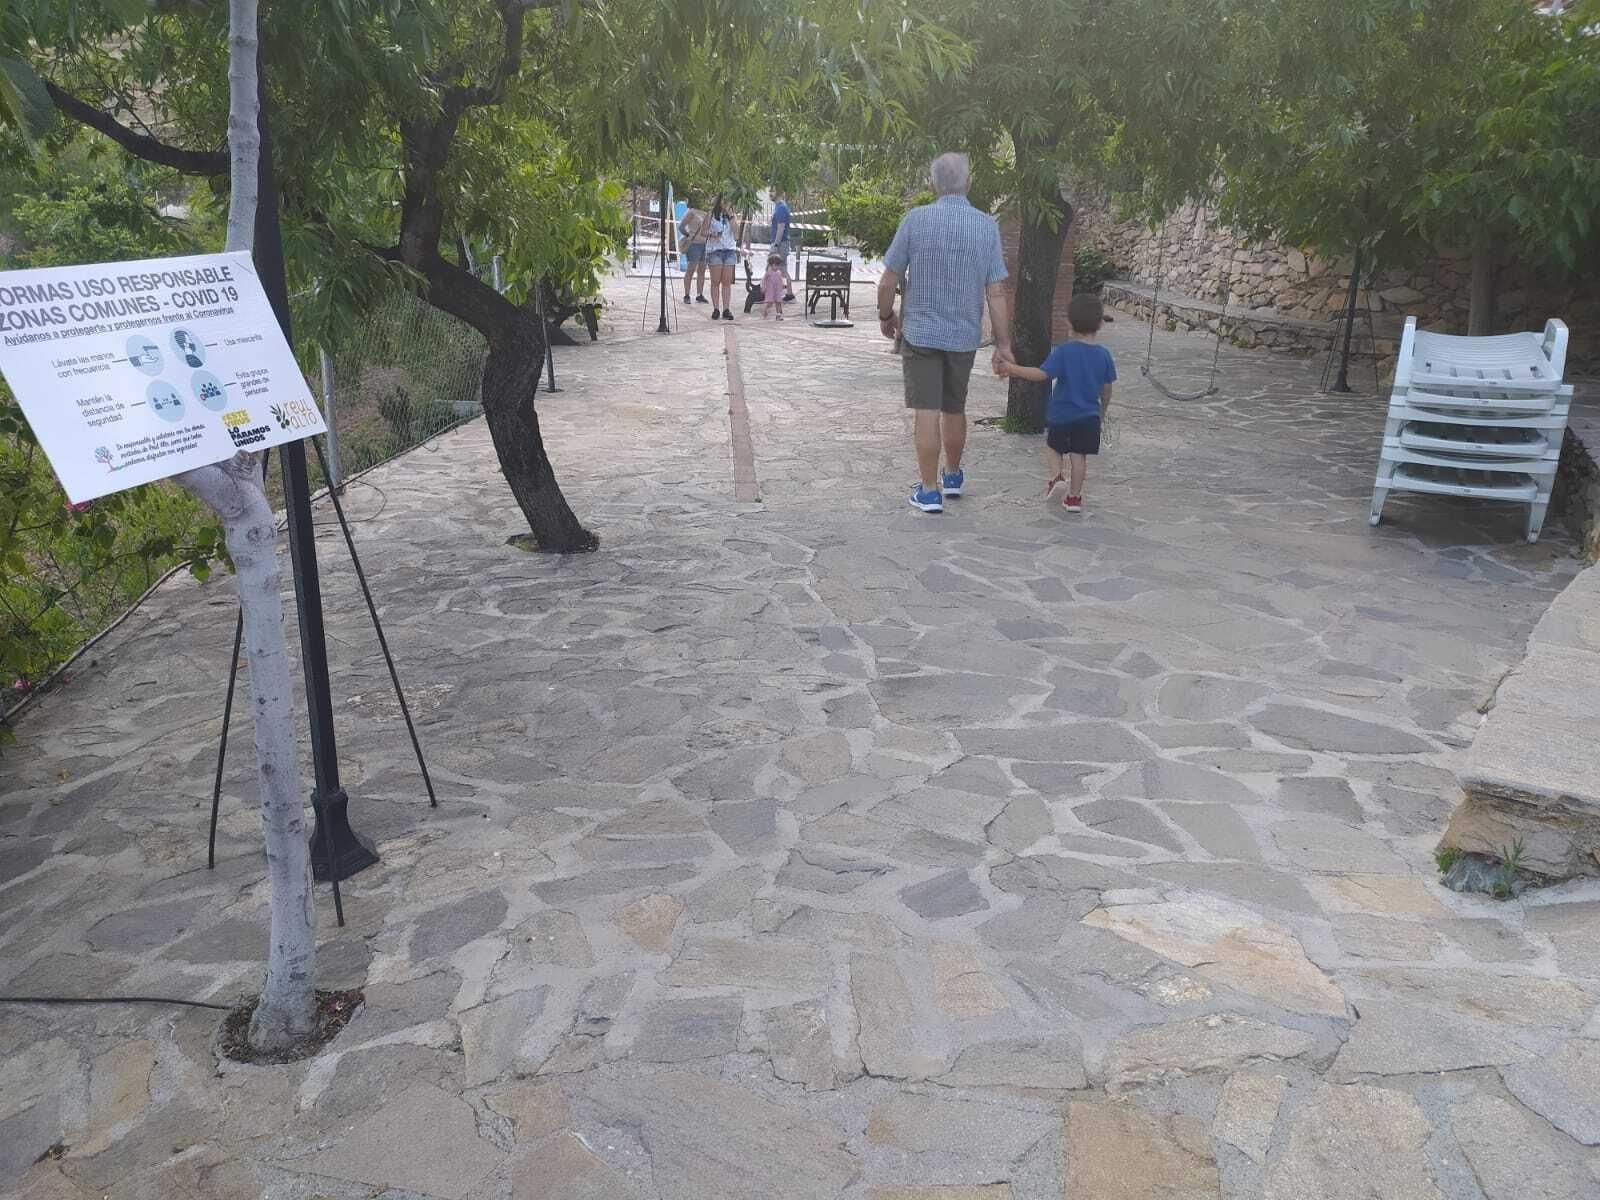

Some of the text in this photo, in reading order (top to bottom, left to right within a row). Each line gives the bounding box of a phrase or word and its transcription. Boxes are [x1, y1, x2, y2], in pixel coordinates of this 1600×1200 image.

[0, 266, 234, 307] ORMAS USO RESPONSABLE
[0, 306, 67, 332] ZONAS
[68, 294, 160, 322] COMUNES
[171, 288, 219, 308] COVID
[221, 285, 239, 301] 19
[227, 426, 240, 434] LO
[230, 425, 271, 440] PARAMOS
[234, 434, 266, 447] UNIDOS
